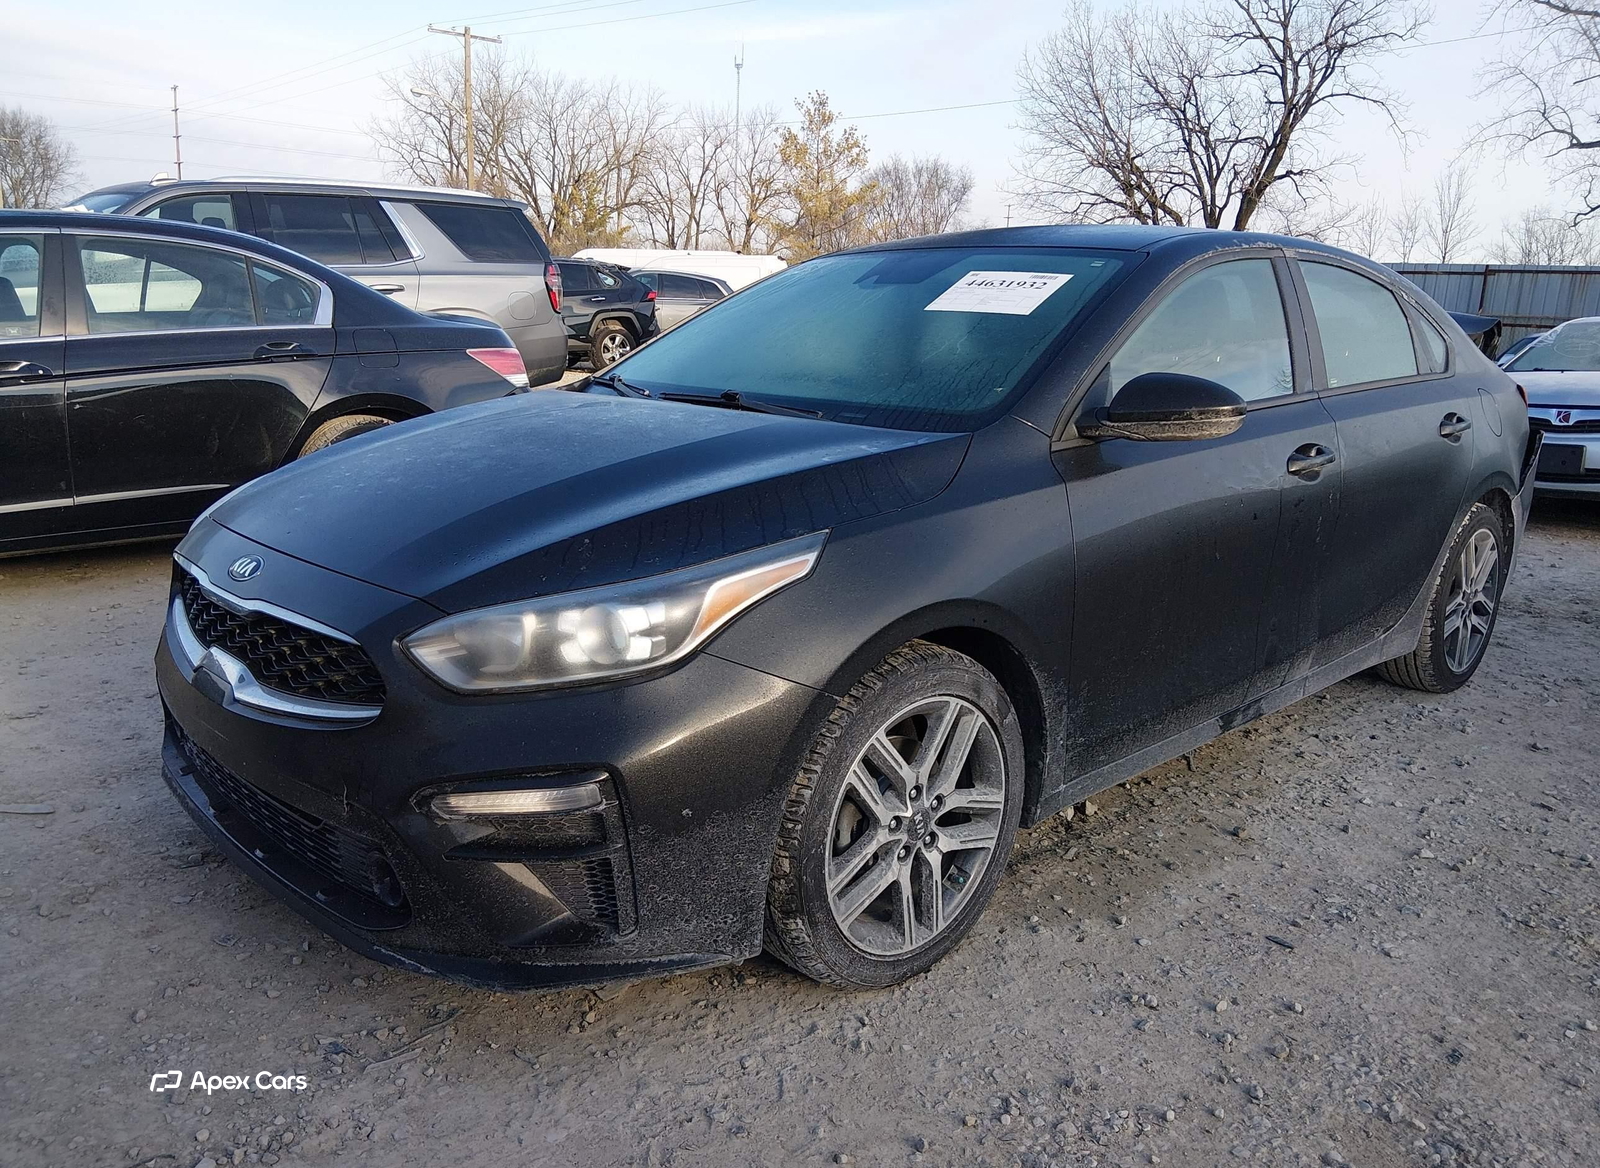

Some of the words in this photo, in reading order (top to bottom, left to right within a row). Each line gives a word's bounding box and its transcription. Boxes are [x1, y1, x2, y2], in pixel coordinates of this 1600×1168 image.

[965, 279, 1048, 290] 44631932
[230, 556, 258, 577] KIA
[914, 812, 925, 839] KIA
